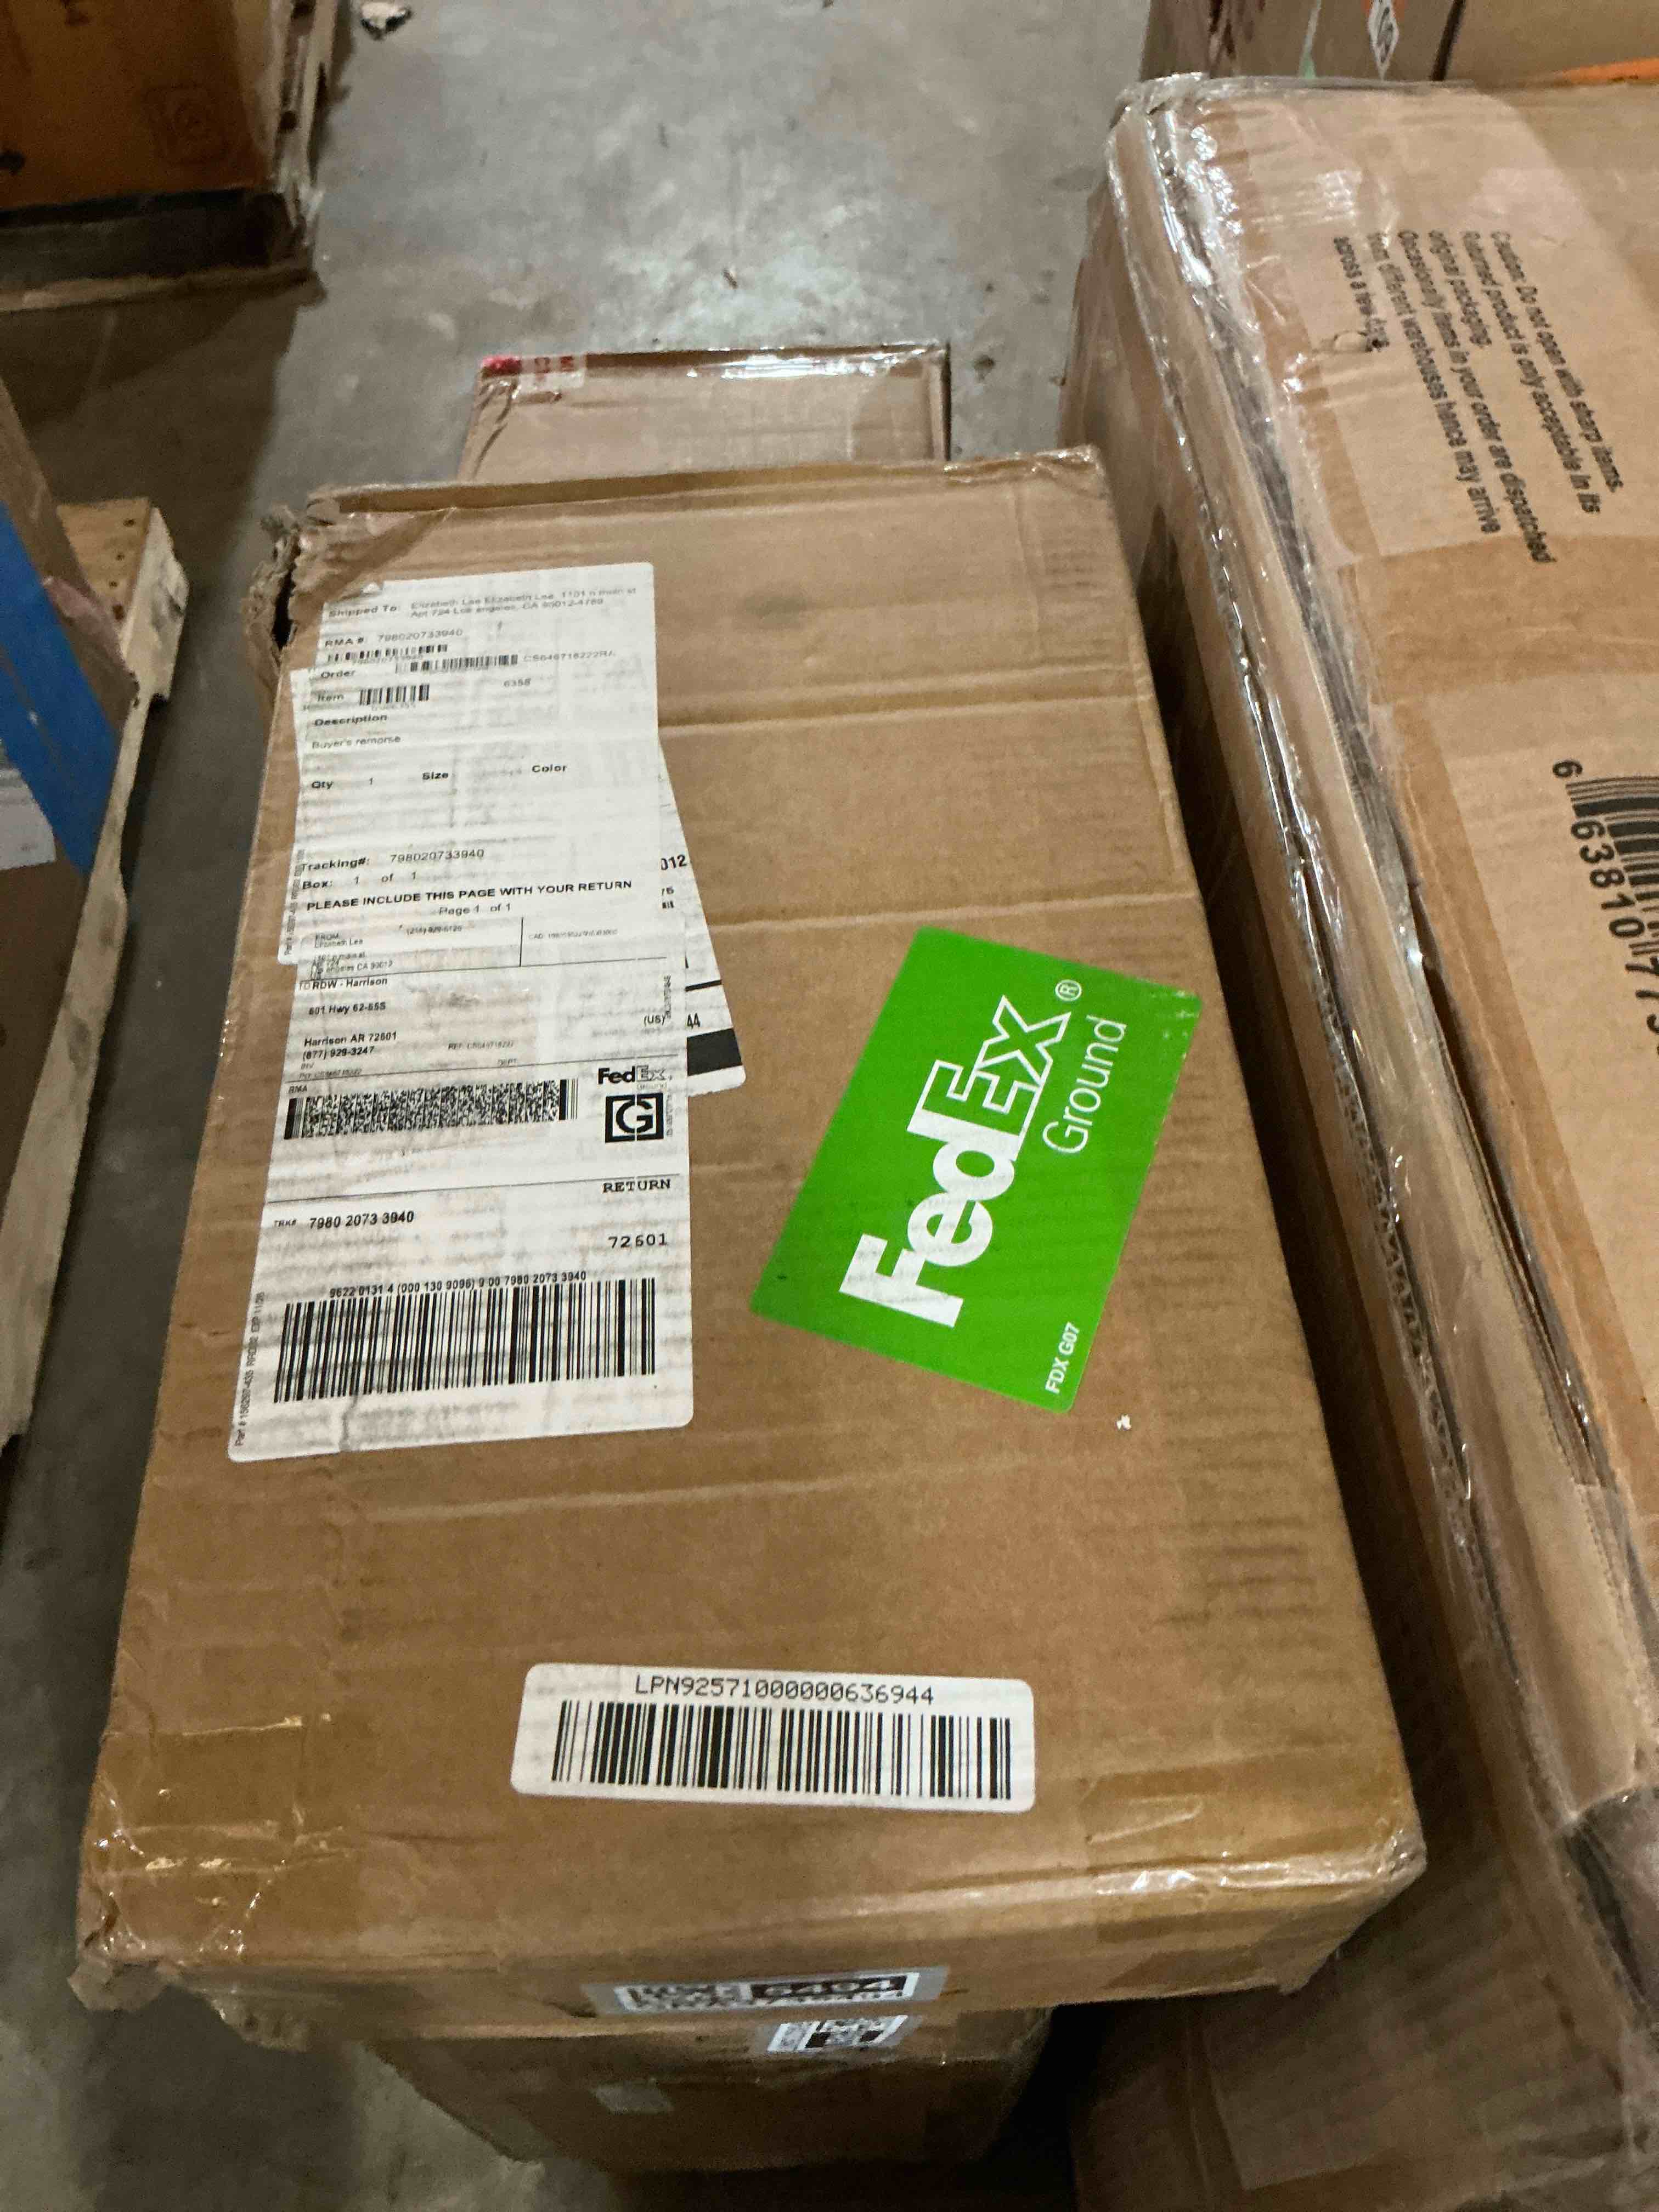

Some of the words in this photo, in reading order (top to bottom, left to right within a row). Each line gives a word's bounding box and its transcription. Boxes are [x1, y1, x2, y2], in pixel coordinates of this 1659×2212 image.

[1334, 236, 1362, 278] across
[1428, 230, 1465, 276] original
[1397, 230, 1446, 309] Occasionally
[1350, 281, 1366, 289] a
[1516, 286, 1538, 303] Do
[1356, 292, 1376, 315] few
[1482, 289, 1525, 340] product
[1526, 307, 1551, 328] not
[1432, 312, 1460, 347] items
[1449, 351, 1470, 363] in
[1510, 343, 1529, 354] is
[1537, 332, 1566, 364] open
[1450, 367, 1483, 399] your
[1517, 358, 1545, 388] only
[1556, 368, 1584, 398] with
[1377, 263, 1417, 316] different
[1401, 318, 1447, 400] warehouses
[1435, 400, 1467, 447] hence
[1454, 450, 1480, 482] may
[1467, 486, 1500, 534] arrive
[1471, 402, 1502, 441] order
[1532, 391, 1582, 470] acceptable
[1570, 401, 1603, 442] sharp
[1488, 445, 1513, 469] are
[1570, 475, 1590, 489] in
[1577, 493, 1600, 514] its
[1500, 473, 1556, 563] dispatched
[329, 606, 378, 618] Shipped
[325, 637, 354, 647] RMA
[320, 670, 356, 679] Order
[317, 693, 345, 702] Item
[314, 713, 388, 727] Description
[312, 738, 353, 749] Buyer's
[356, 734, 402, 746] remorse
[422, 771, 449, 781] Size
[531, 763, 567, 773] Color
[1552, 759, 1583, 779] 6
[311, 779, 334, 790] Qty
[390, 848, 484, 864] 798020733940
[302, 880, 333, 890] Box:
[355, 876, 360, 885] 1
[381, 873, 393, 883] of
[411, 872, 417, 881] 1
[1570, 820, 1645, 939] 63810
[307, 898, 359, 911] PLEASE
[363, 893, 421, 906] INCLUDE
[426, 890, 454, 900] THIS
[459, 887, 495, 899] PAGE
[500, 885, 533, 896] WITH
[538, 883, 574, 894] YOUR
[578, 879, 632, 892] RETURN
[439, 906, 470, 917] Page
[474, 904, 480, 913] 1
[490, 904, 501, 912] of
[506, 903, 511, 911] 1
[346, 978, 388, 989] Harrison
[329, 1005, 349, 1015] Hwy
[304, 1036, 348, 1047] Harrison
[351, 1034, 365, 1043] AR
[302, 1050, 328, 1062] (877)
[330, 1046, 375, 1057] 929-3247
[597, 1065, 667, 1085] FedEx
[1043, 1015, 1127, 1154] Ground
[616, 1099, 653, 1134] G
[838, 995, 1071, 1328] FedEx
[602, 1178, 671, 1194] RETURN
[309, 1215, 341, 1229] 7980
[346, 1212, 378, 1227] 2073
[382, 1210, 414, 1224] 3940
[608, 1233, 668, 1249] 72601
[329, 1285, 358, 1299] 9622
[387, 1284, 394, 1293] 4
[397, 1281, 420, 1295] (000
[488, 1277, 500, 1286] 00
[504, 1275, 529, 1286] 7980
[532, 1272, 558, 1284] 2073
[561, 1271, 586, 1282] 3940
[1045, 1355, 1069, 1394] FDX
[1058, 1322, 1081, 1357] G07
[634, 1674, 935, 1706] LPN92571000000636944
